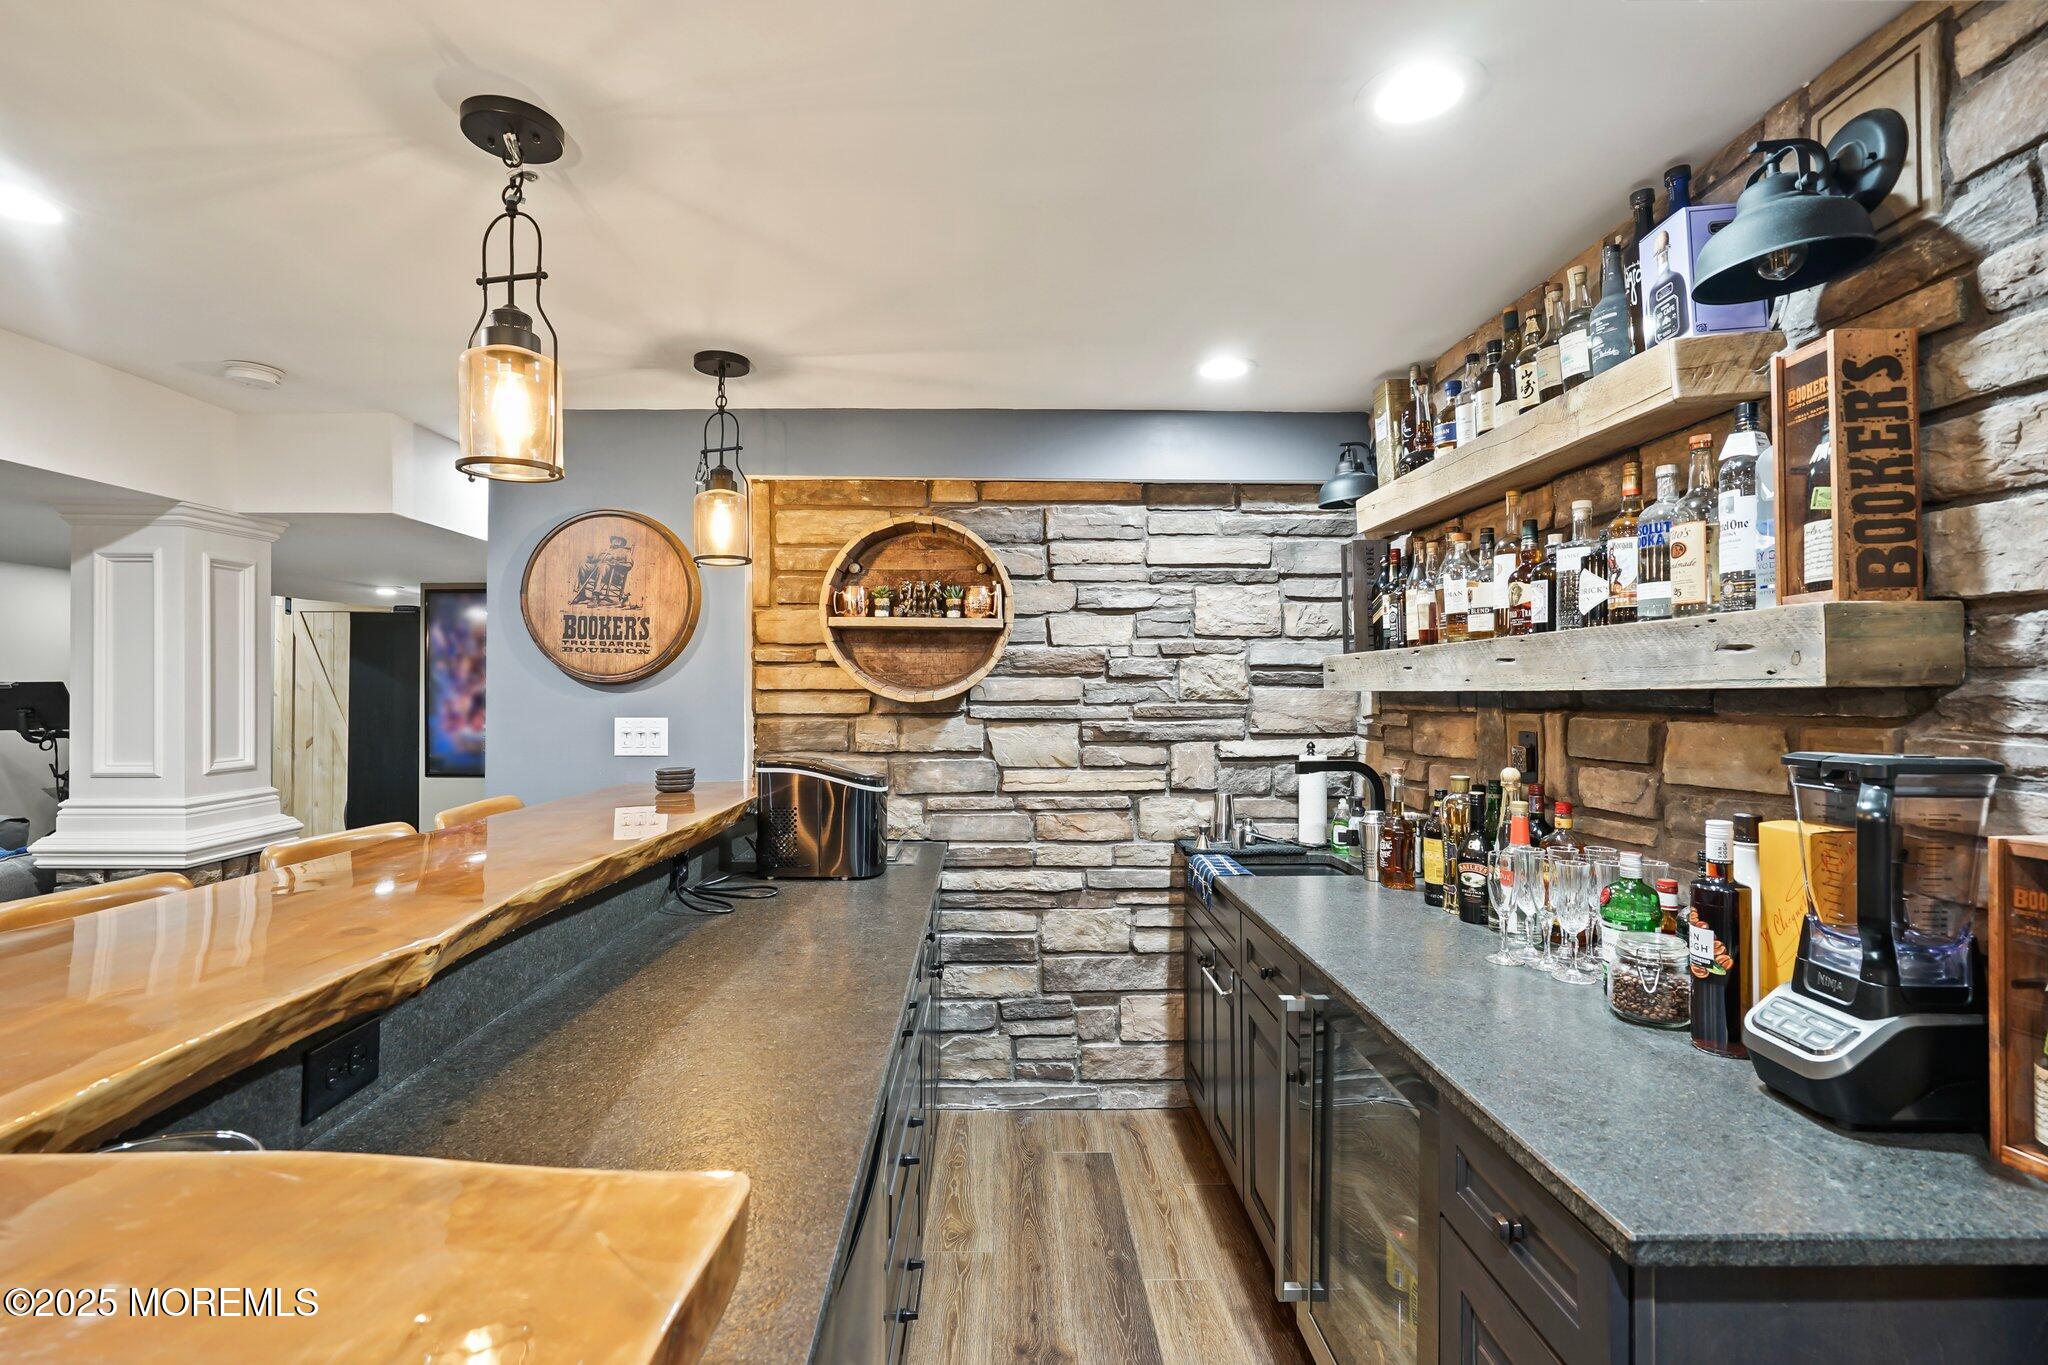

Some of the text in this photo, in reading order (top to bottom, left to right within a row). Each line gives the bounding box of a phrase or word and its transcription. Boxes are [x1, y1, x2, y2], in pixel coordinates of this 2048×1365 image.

[1787, 376, 1828, 408] BOOKER'
[1842, 355, 1918, 589] BOOKER'S
[1638, 521, 1672, 537] SOLUT
[1729, 520, 1749, 530] One
[1637, 534, 1666, 549] ODKA
[562, 614, 651, 641] BOOKER'S
[562, 646, 651, 655] BOURBON
[599, 640, 651, 648] BARREL
[1817, 971, 1844, 993] NINJA
